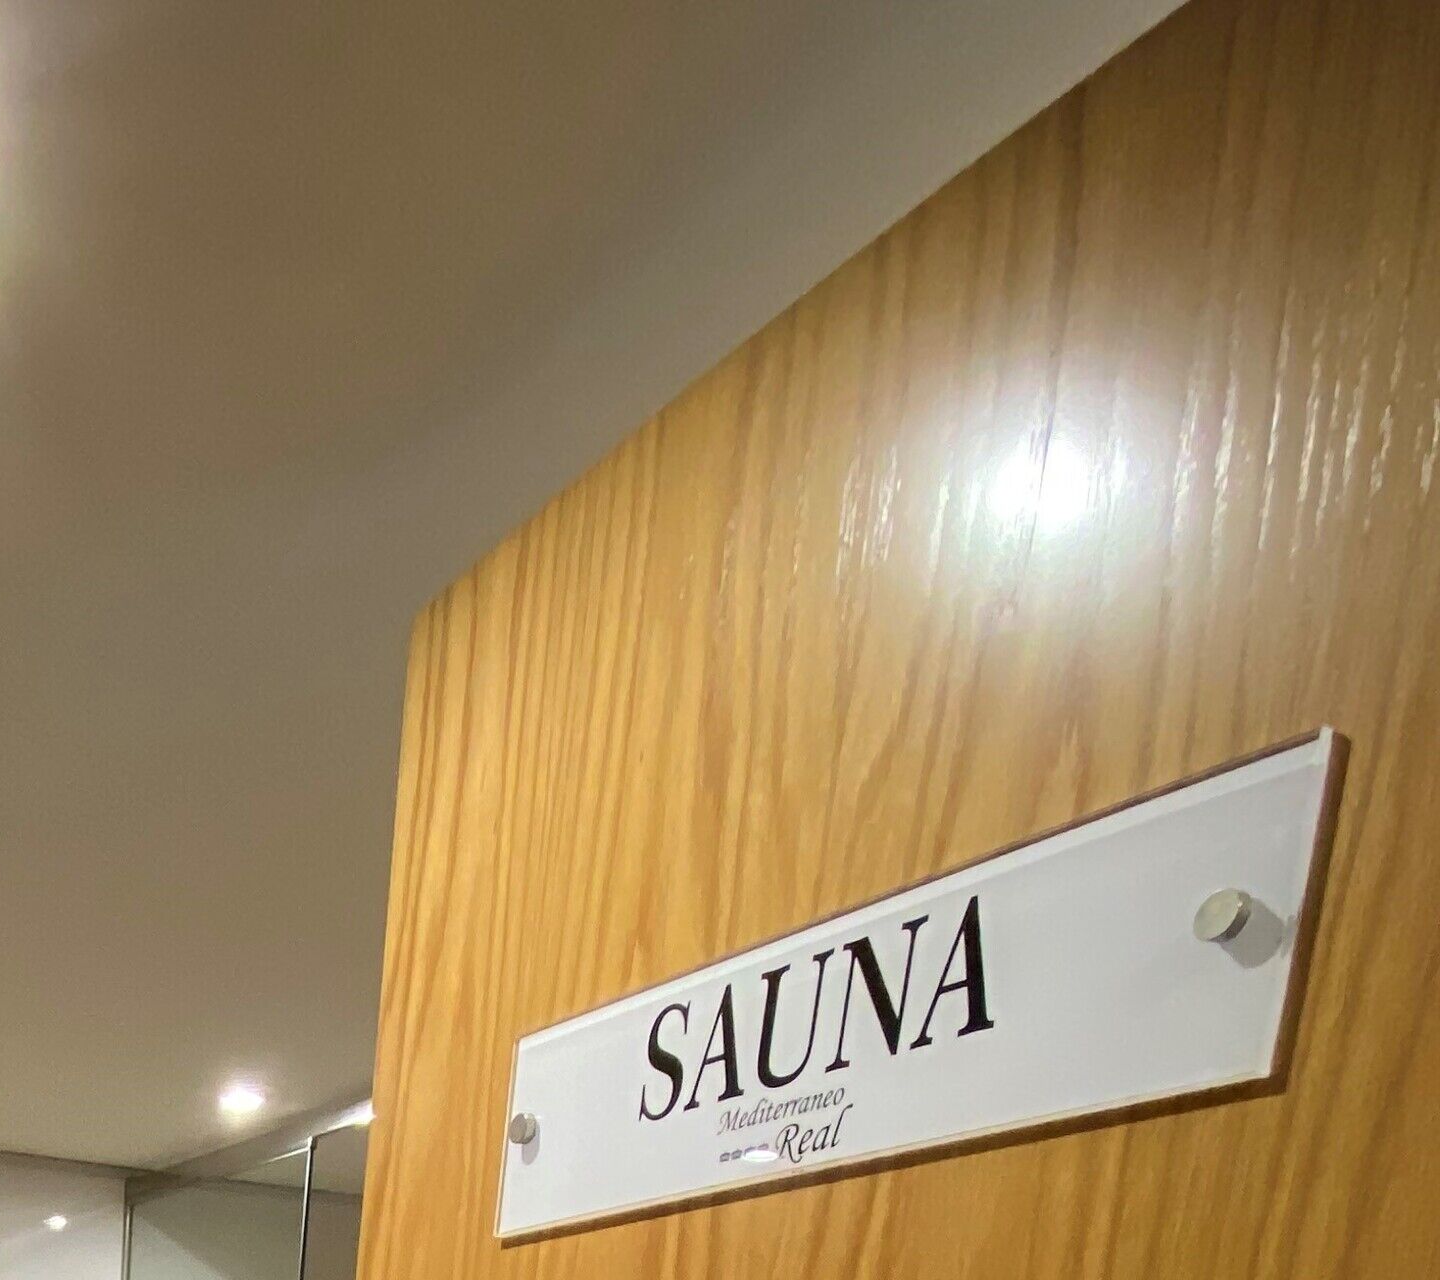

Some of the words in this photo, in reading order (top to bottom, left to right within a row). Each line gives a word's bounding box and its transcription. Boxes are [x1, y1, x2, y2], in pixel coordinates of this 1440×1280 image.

[639, 894, 994, 1123] SAUNA
[716, 1087, 846, 1136] Mediterraneo
[775, 1103, 854, 1164] Real
